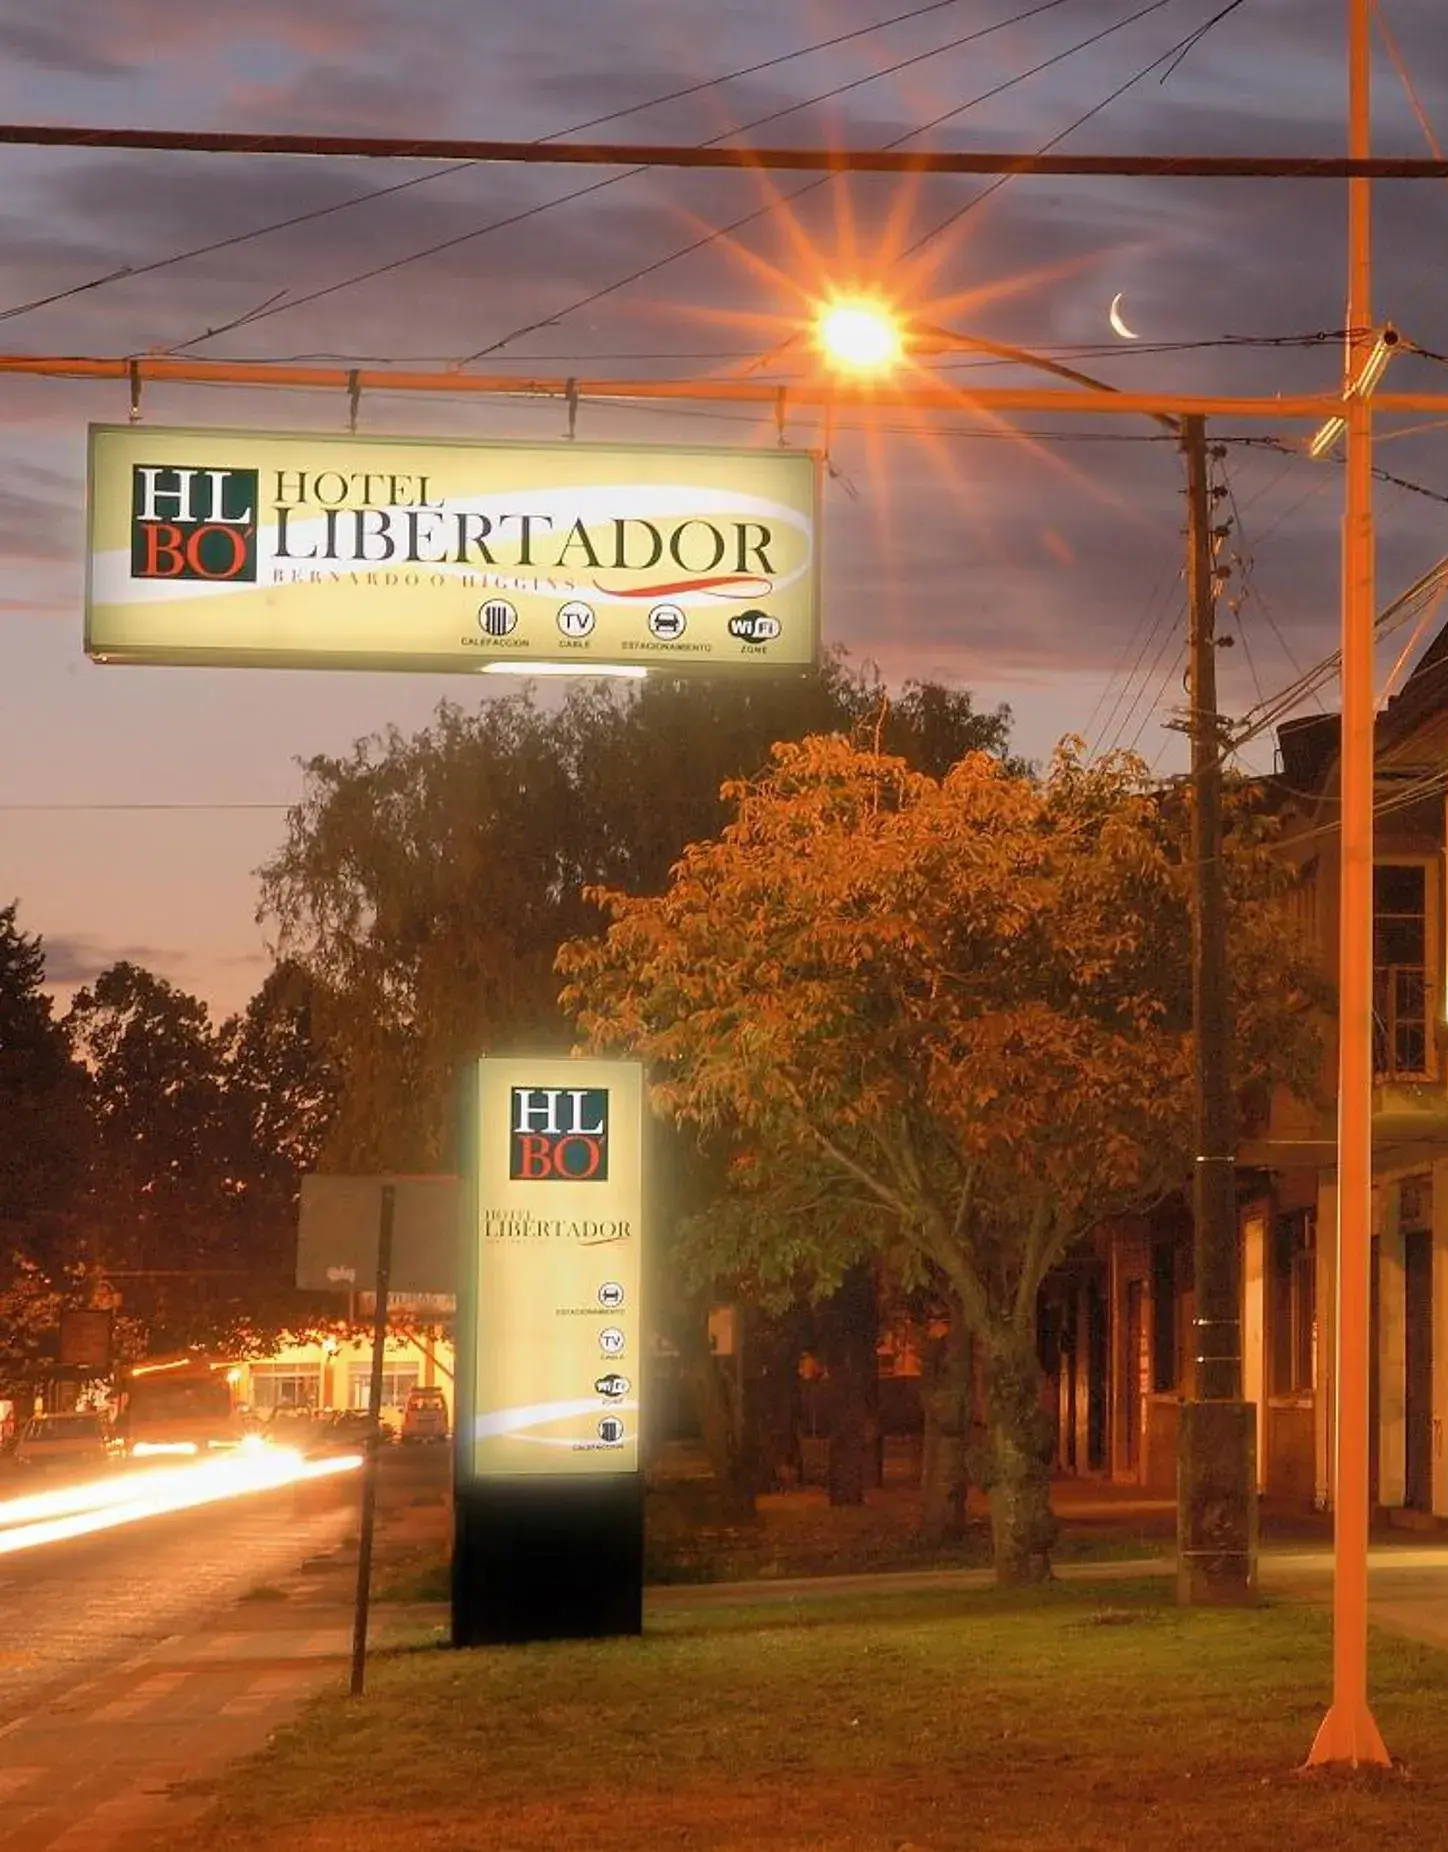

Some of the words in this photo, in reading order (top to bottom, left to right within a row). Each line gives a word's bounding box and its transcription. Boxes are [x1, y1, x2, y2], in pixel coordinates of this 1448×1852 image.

[136, 468, 251, 524] HL
[274, 470, 445, 508] HOTEL
[271, 506, 777, 575] LIBERTADOR
[273, 568, 419, 586] BERNARDO
[563, 613, 590, 629] TV
[558, 640, 591, 649] CABLE
[621, 641, 712, 653] ESTACIONAMIENTO
[740, 645, 768, 655] ZONE
[514, 1090, 603, 1135] HL
[485, 1209, 535, 1224] HOTEL
[485, 1220, 632, 1238] LIBERTADOR
[603, 1335, 621, 1347] TV
